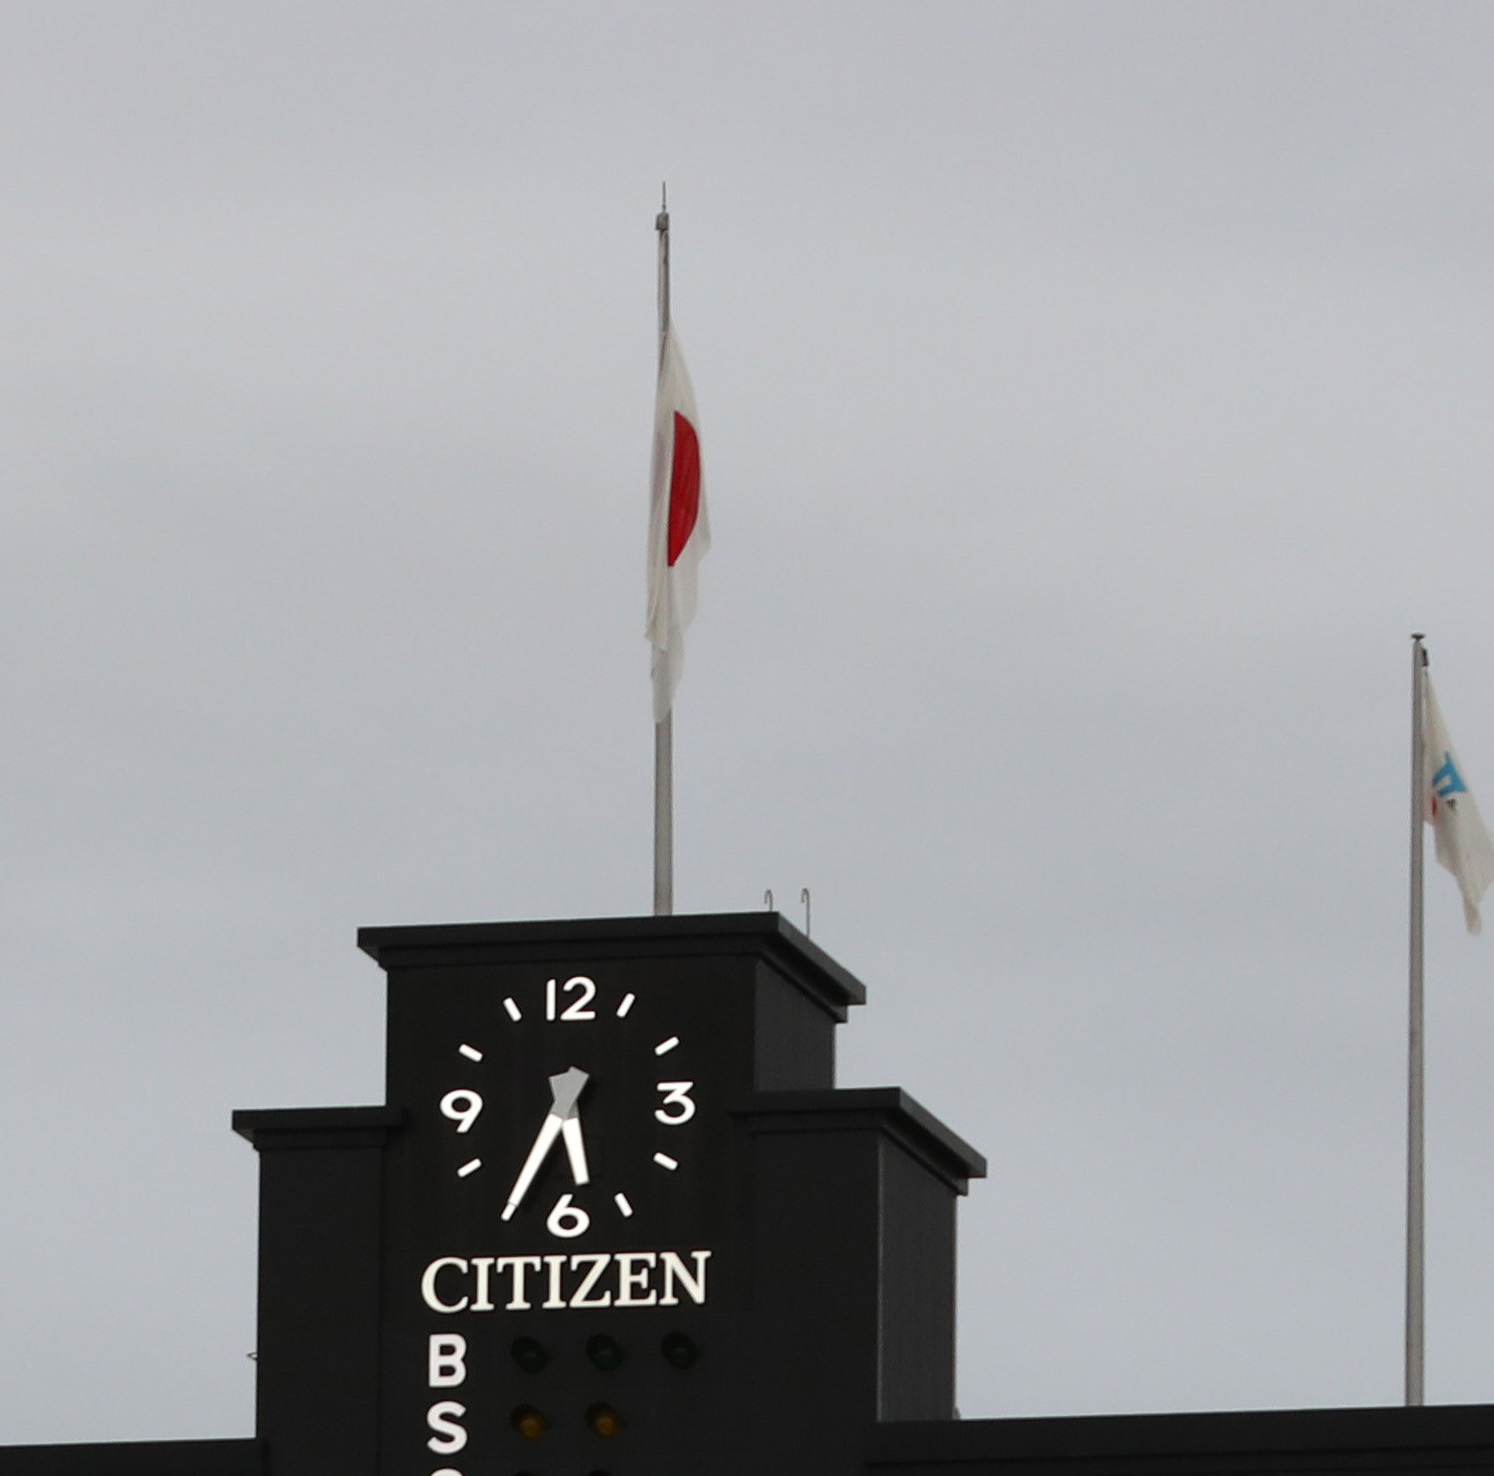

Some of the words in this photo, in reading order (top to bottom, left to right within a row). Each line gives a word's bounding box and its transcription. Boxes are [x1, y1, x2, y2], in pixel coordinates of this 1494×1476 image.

[547, 977, 595, 1020] 12
[441, 1090, 482, 1132] 9
[655, 1082, 695, 1124] 3
[547, 1195, 589, 1237] 6
[422, 1251, 711, 1312] CITIZEN
[430, 1334, 465, 1386] B
[428, 1402, 466, 1453] S
